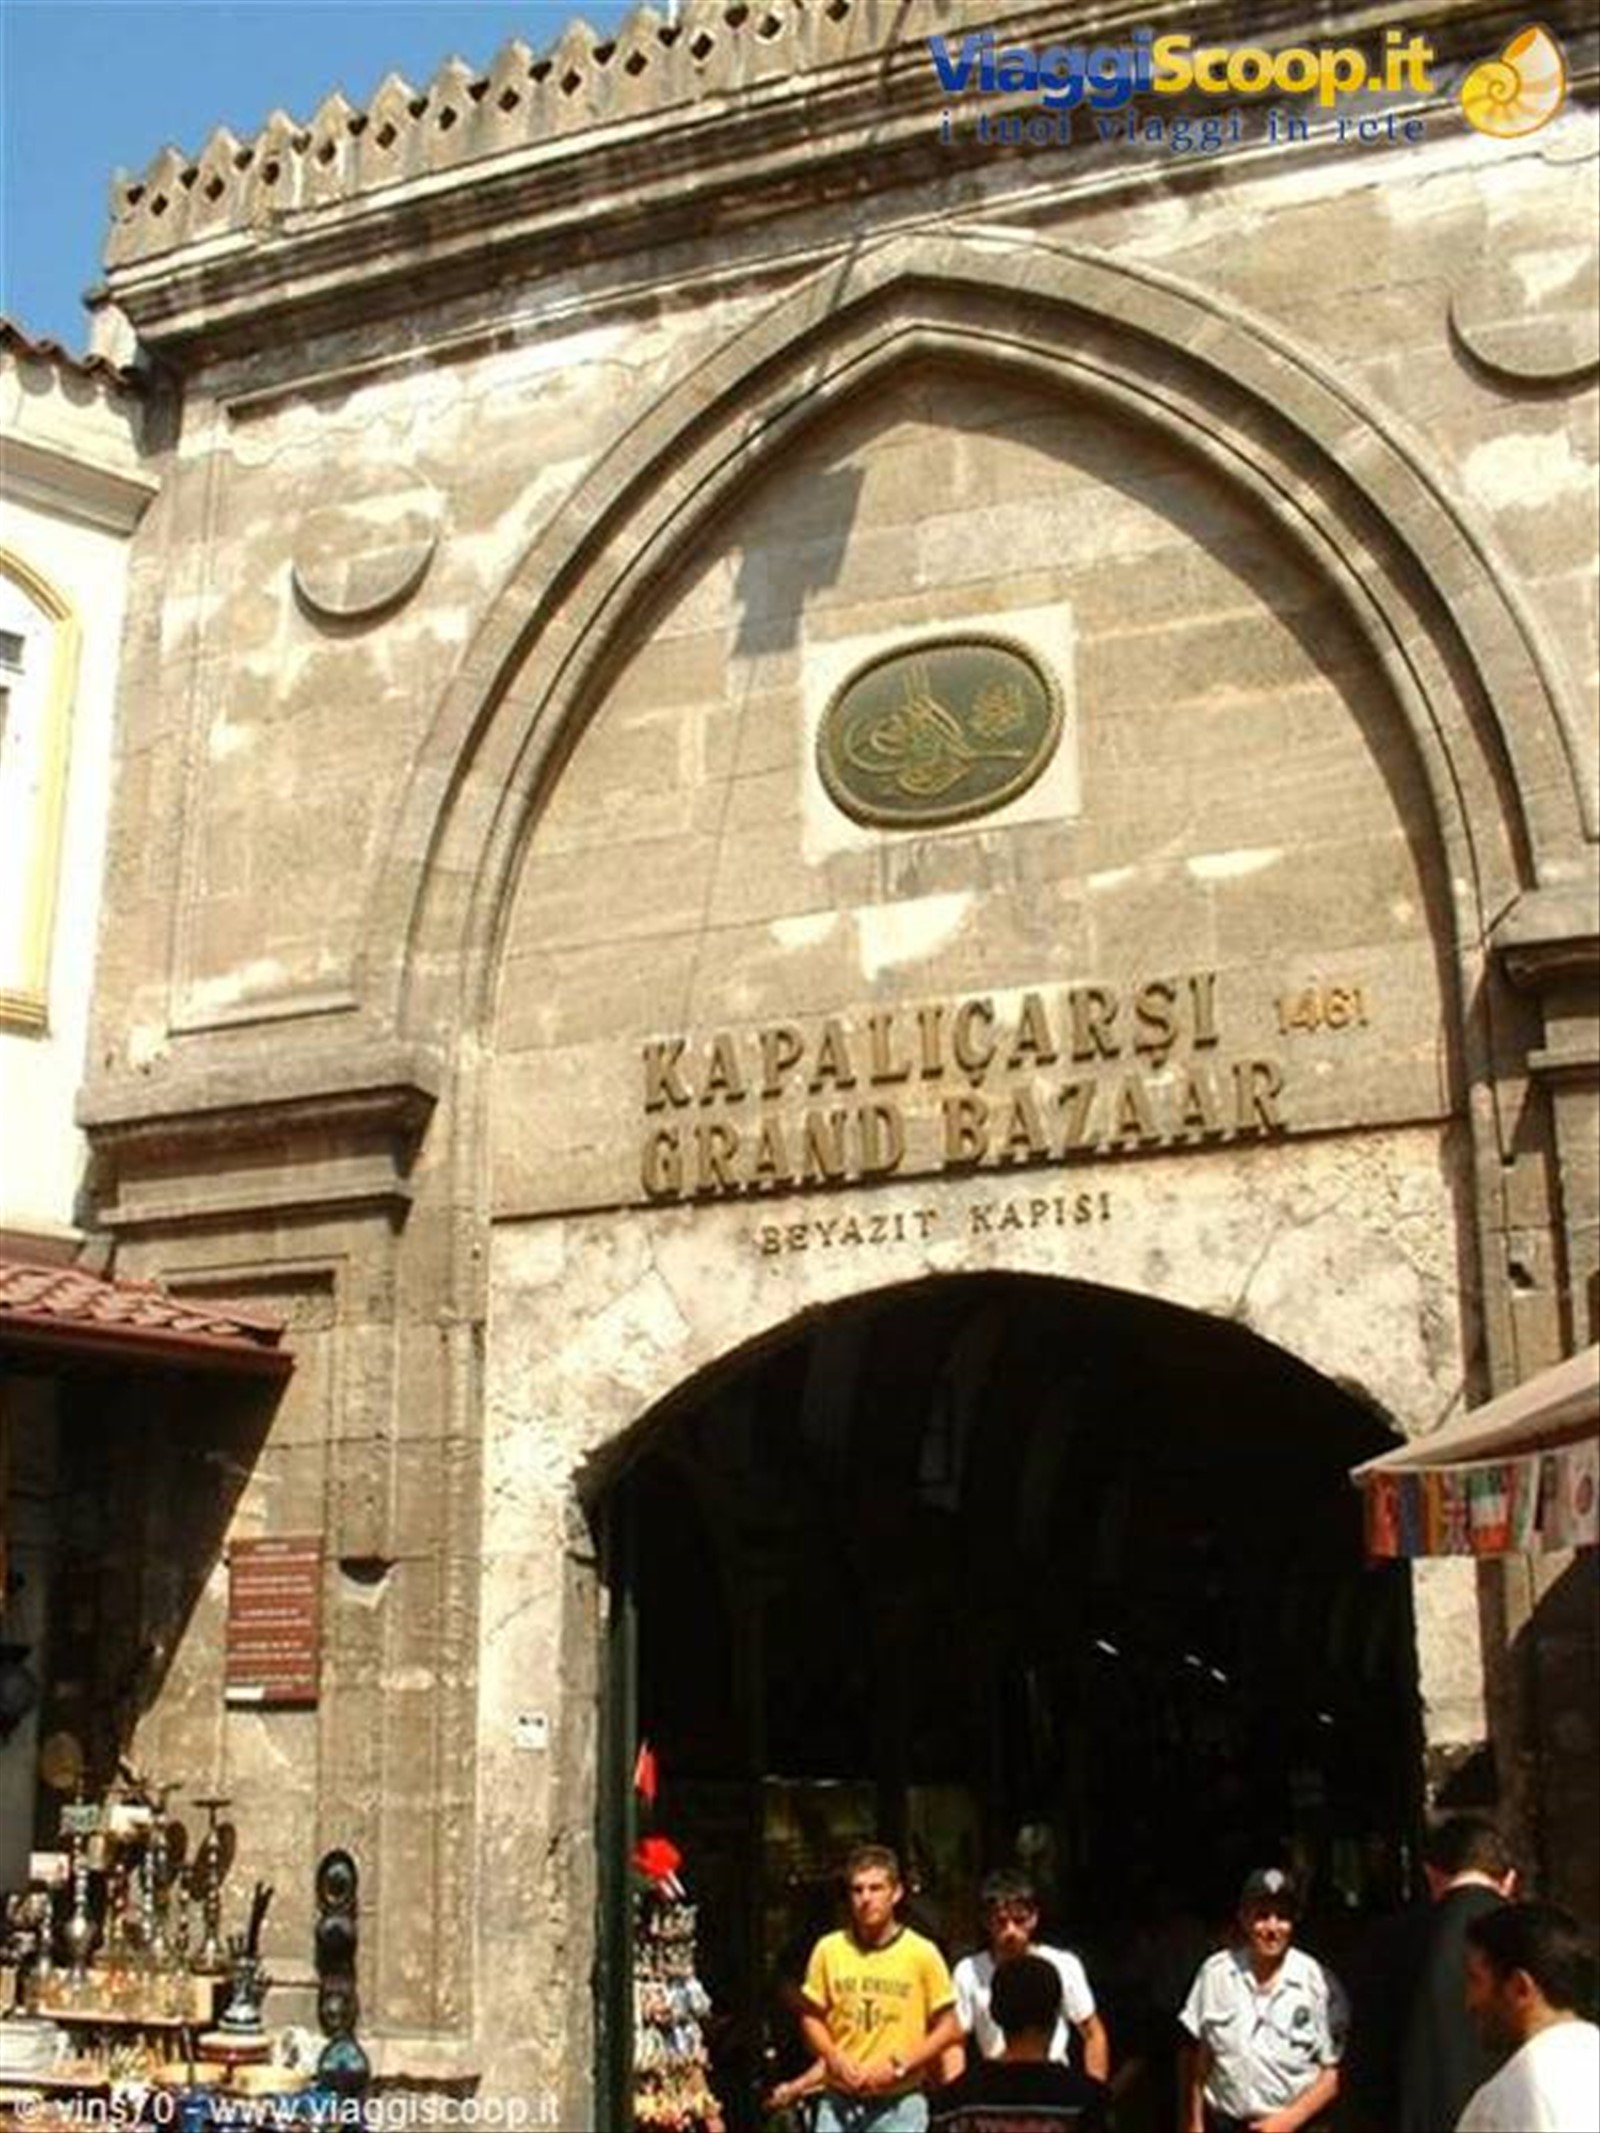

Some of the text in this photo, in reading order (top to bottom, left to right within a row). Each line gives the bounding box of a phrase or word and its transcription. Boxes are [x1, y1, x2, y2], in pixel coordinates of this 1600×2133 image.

[641, 971, 1220, 1114] KAPALIÇARŞI
[1277, 986, 1370, 1037] 1461
[640, 1059, 1289, 1201] GRAND BAZAAR
[760, 1191, 1113, 1257] BEYAZIT KAPISI
